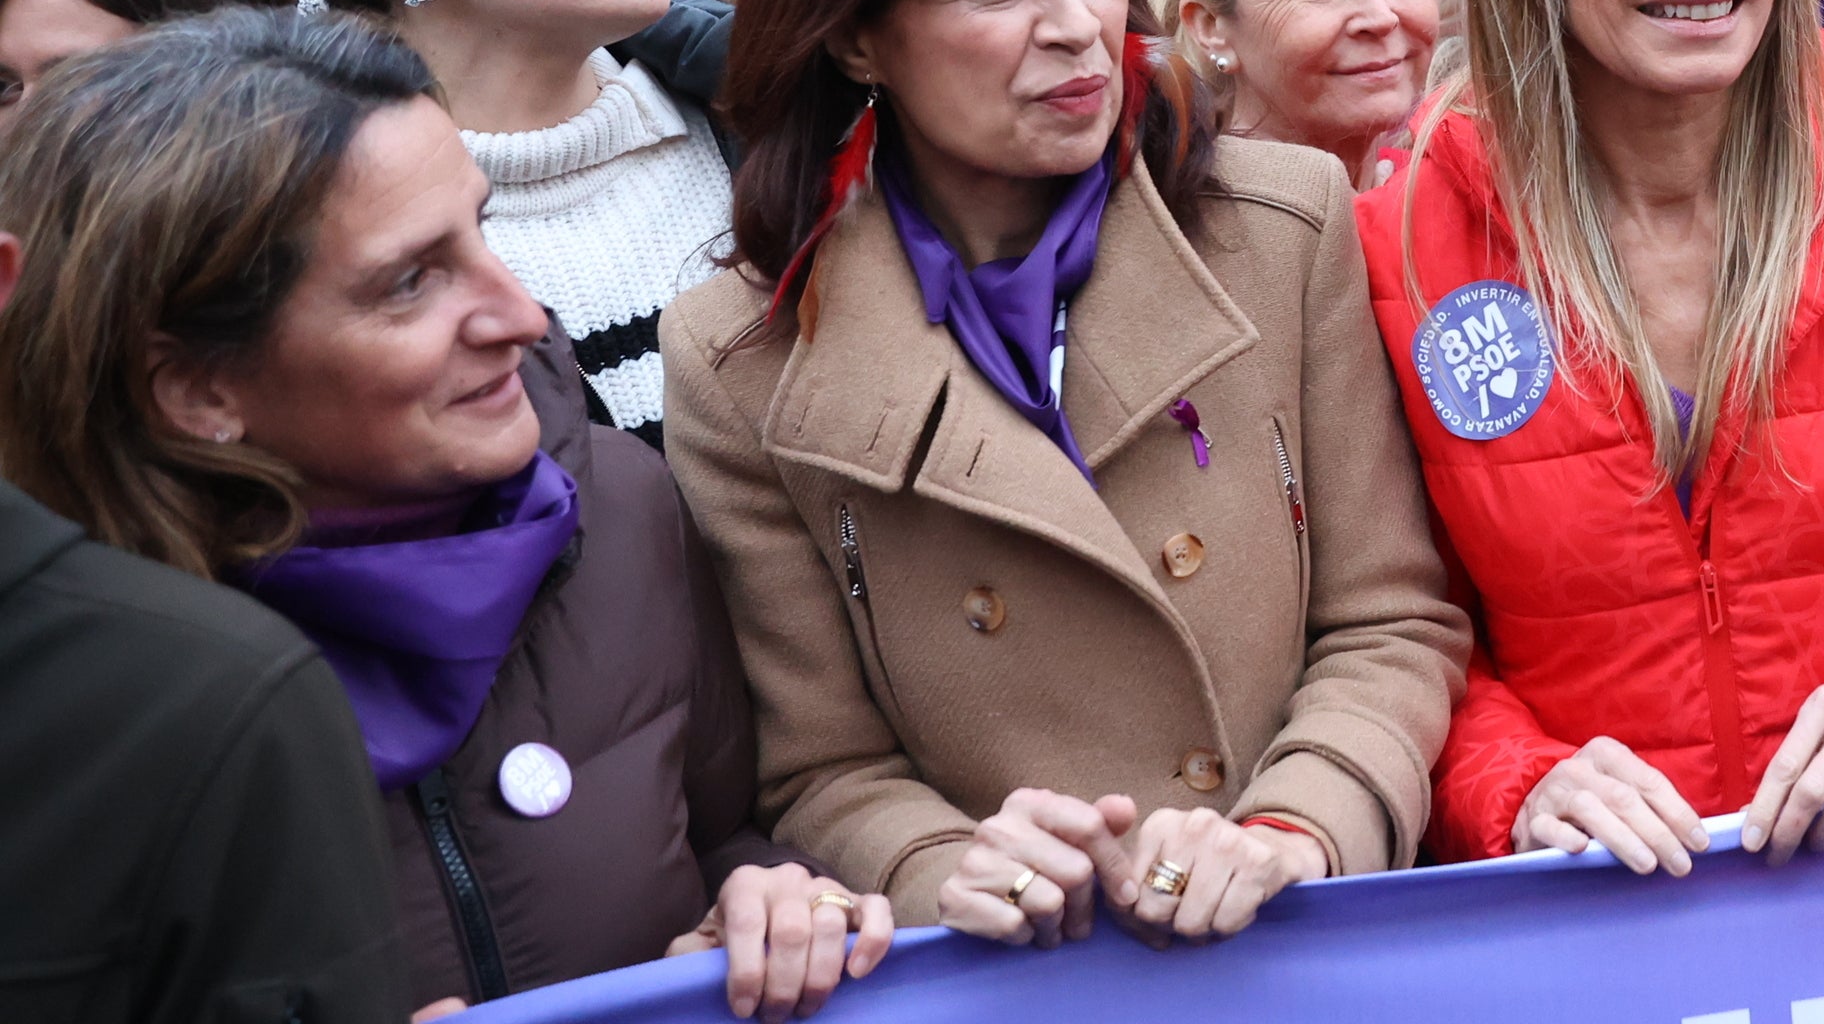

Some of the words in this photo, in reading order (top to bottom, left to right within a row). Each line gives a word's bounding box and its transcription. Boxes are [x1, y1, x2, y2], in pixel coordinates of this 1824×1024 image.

[1455, 288, 1522, 308] INVERTIR
[1521, 301, 1538, 321] EN
[1439, 301, 1509, 364] 8M
[1452, 332, 1521, 393] PSOE
[1427, 388, 1462, 426] COMO
[1465, 402, 1528, 433] AVANZAR
